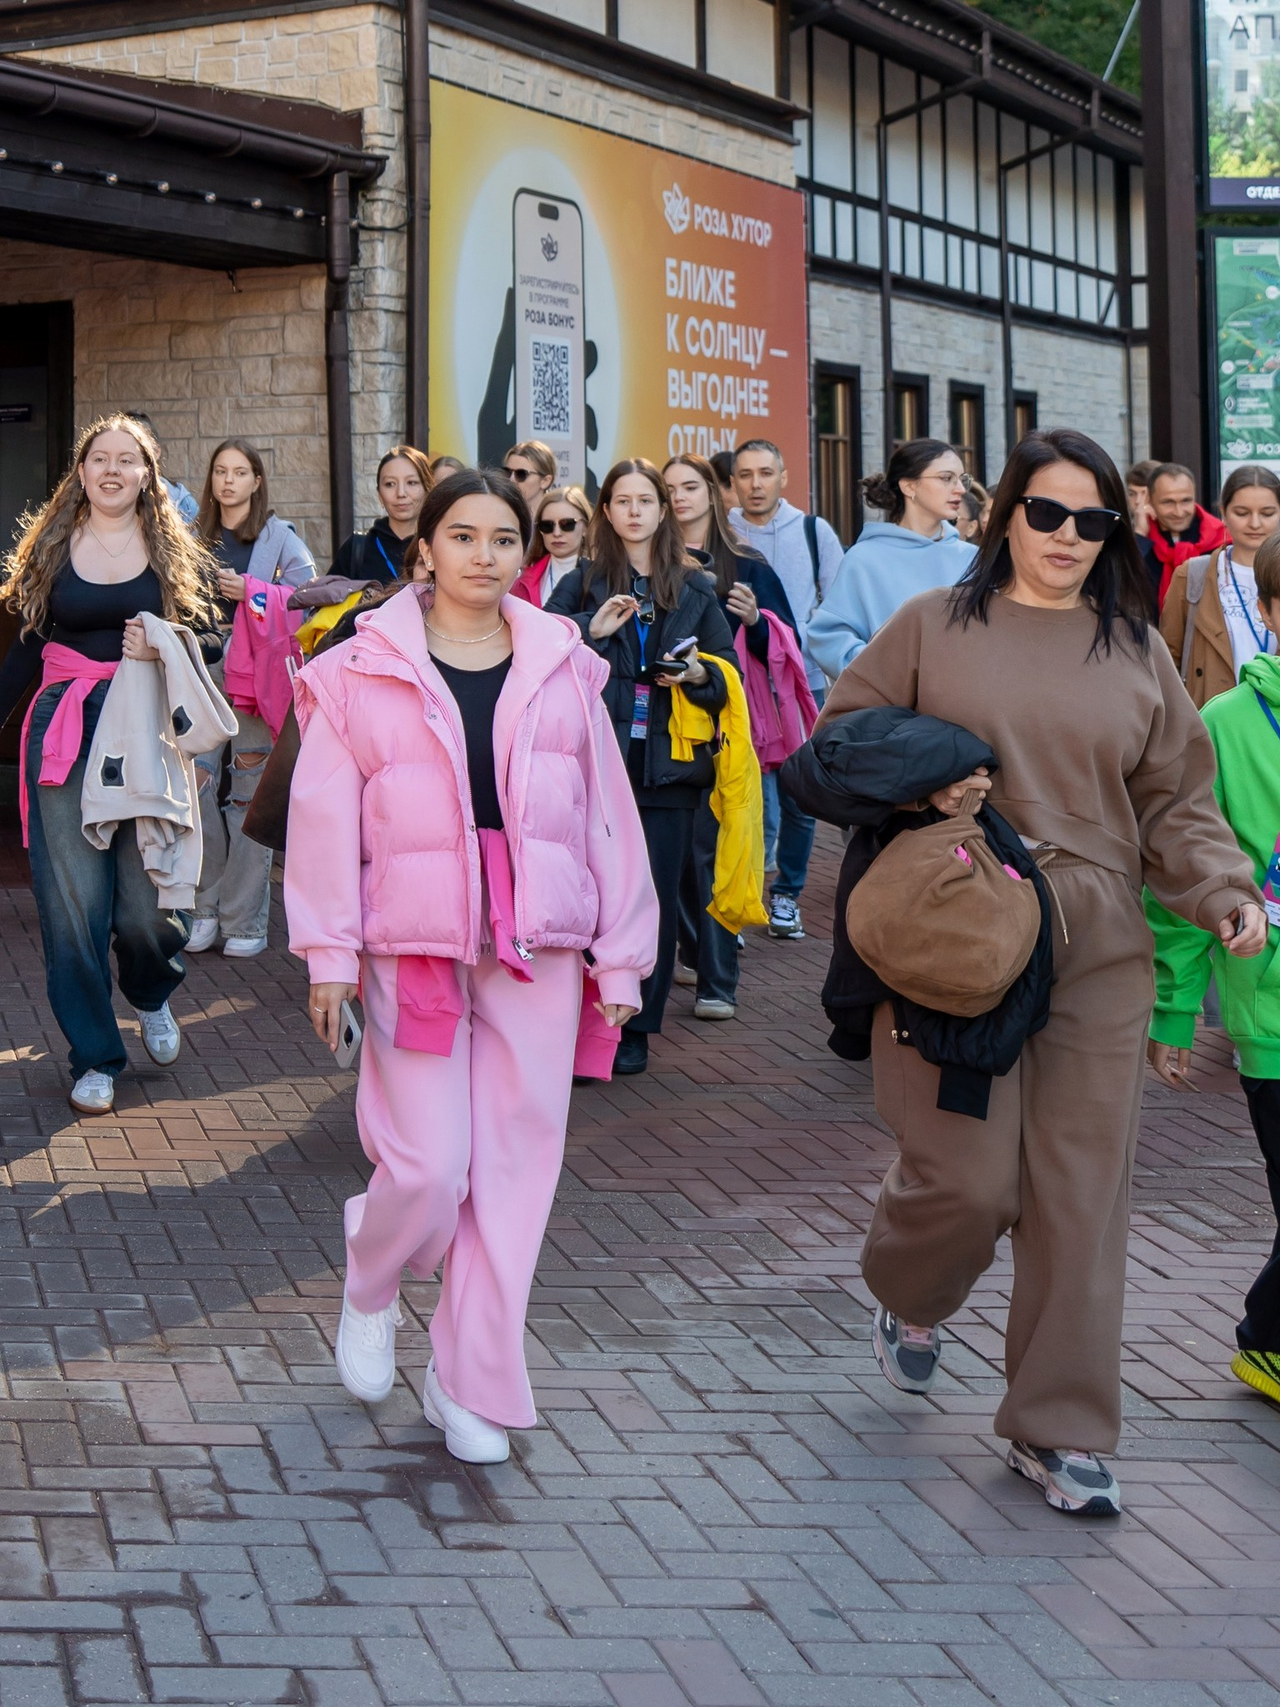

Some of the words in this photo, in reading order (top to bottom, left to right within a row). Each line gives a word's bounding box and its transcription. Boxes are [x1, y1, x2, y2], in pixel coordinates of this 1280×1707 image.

[694, 202, 729, 239] РОЗА
[731, 212, 773, 248] ХУТОР
[665, 256, 737, 309] БЛИЖЕ
[525, 308, 546, 325] РОЗА
[548, 311, 575, 330] БОНУС
[666, 312, 680, 353] К
[685, 315, 767, 371] СОЛНЦУ
[667, 367, 770, 420] ВЫГОДНЕЕ
